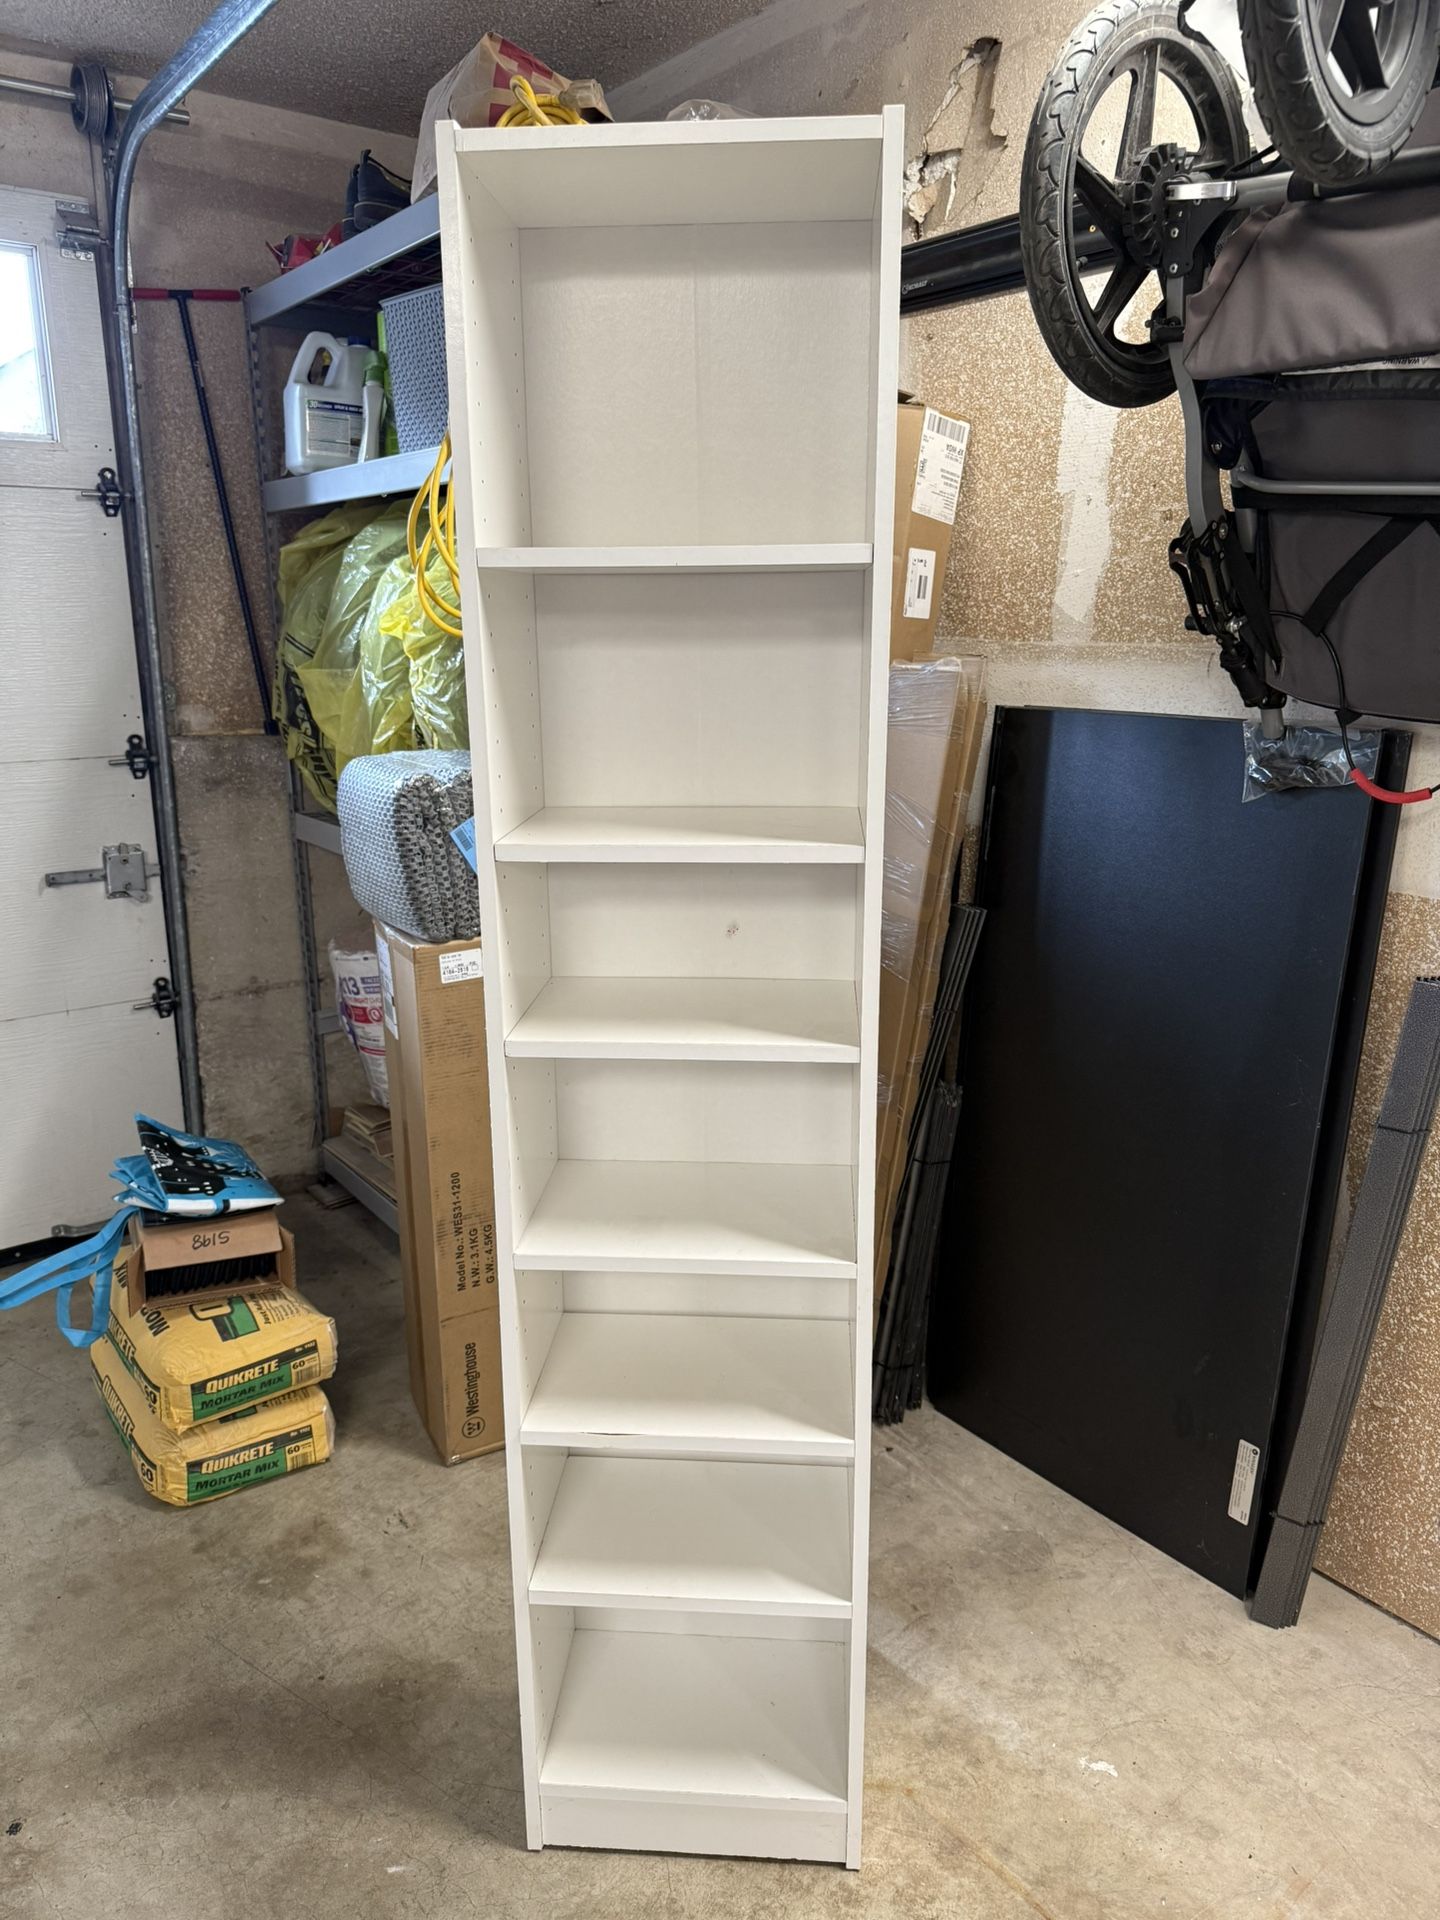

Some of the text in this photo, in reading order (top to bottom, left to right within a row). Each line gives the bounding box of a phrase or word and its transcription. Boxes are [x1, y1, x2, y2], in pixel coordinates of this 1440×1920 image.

[450, 1171, 466, 1292] Model No.: WES31-1200
[468, 1227, 481, 1288] N.W.: 3.1KG
[483, 1223, 495, 1284] G.W.: 4.5KG
[205, 1358, 280, 1395] QUIKRETE
[292, 1360, 306, 1370] 60
[464, 1342, 481, 1418] Westinghouse
[102, 1374, 136, 1438] QUIKRETE
[201, 1384, 256, 1410] MORTAR
[259, 1375, 285, 1389] MIX
[201, 1441, 275, 1475] QUIKRETE
[287, 1445, 301, 1455] 60
[195, 1468, 252, 1491] MORTAR
[255, 1459, 280, 1475] MIX
